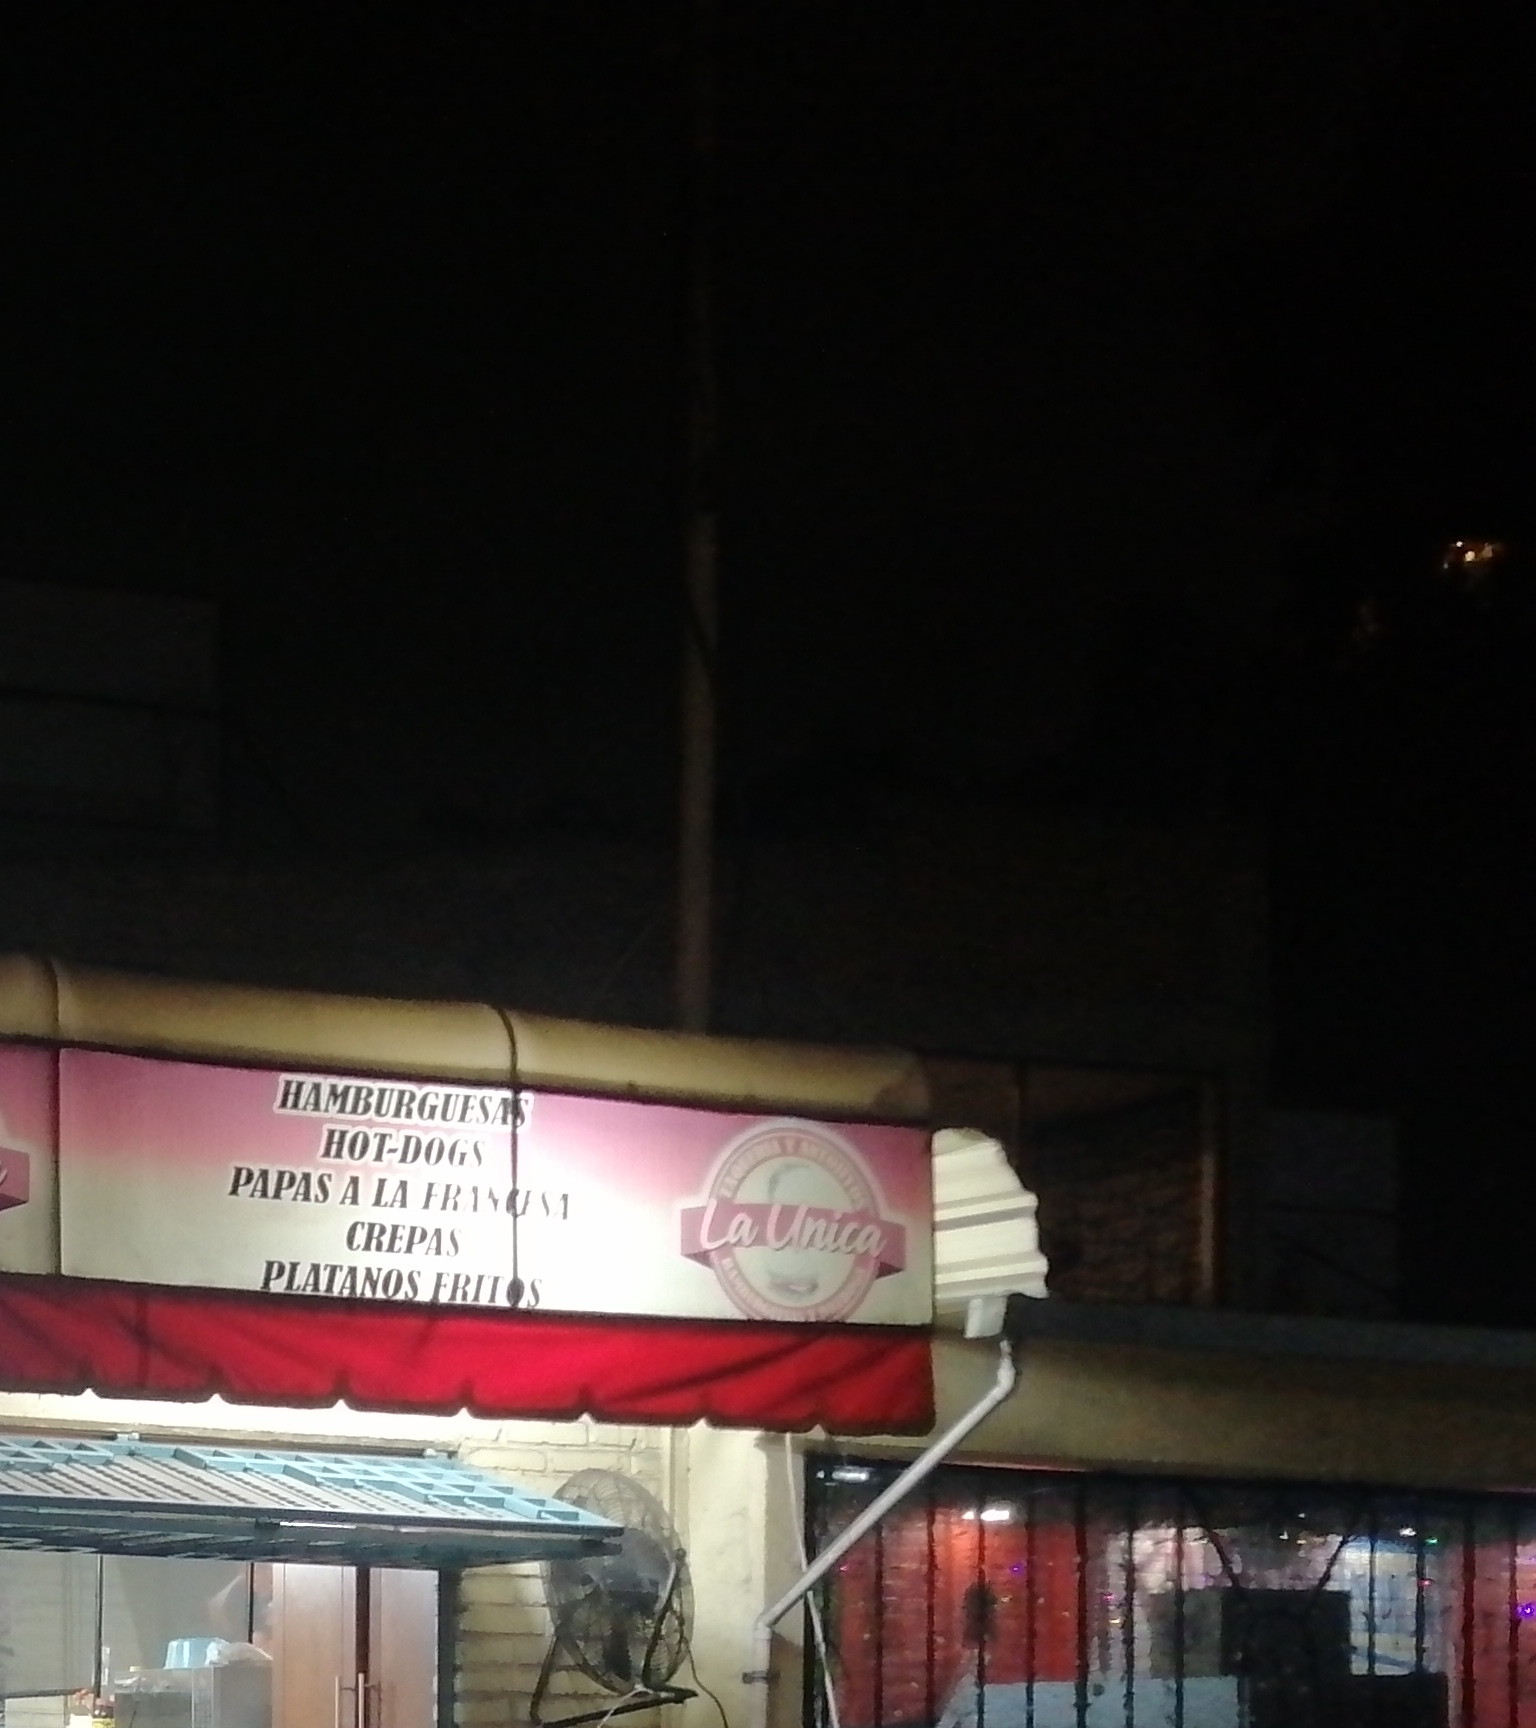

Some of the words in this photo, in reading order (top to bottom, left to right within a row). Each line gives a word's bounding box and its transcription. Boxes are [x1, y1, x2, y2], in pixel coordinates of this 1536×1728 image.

[278, 1078, 530, 1128] HAMBURGUESAS
[320, 1127, 487, 1168] HOT-DOGS
[228, 1165, 333, 1205] PAPAS
[339, 1174, 361, 1206] A
[371, 1177, 408, 1209] LA
[345, 1220, 463, 1258] CREPAS
[699, 1198, 759, 1250] La
[767, 1204, 888, 1259] Unica
[259, 1259, 422, 1301] PLATANOS
[430, 1271, 543, 1309] FRITOS
